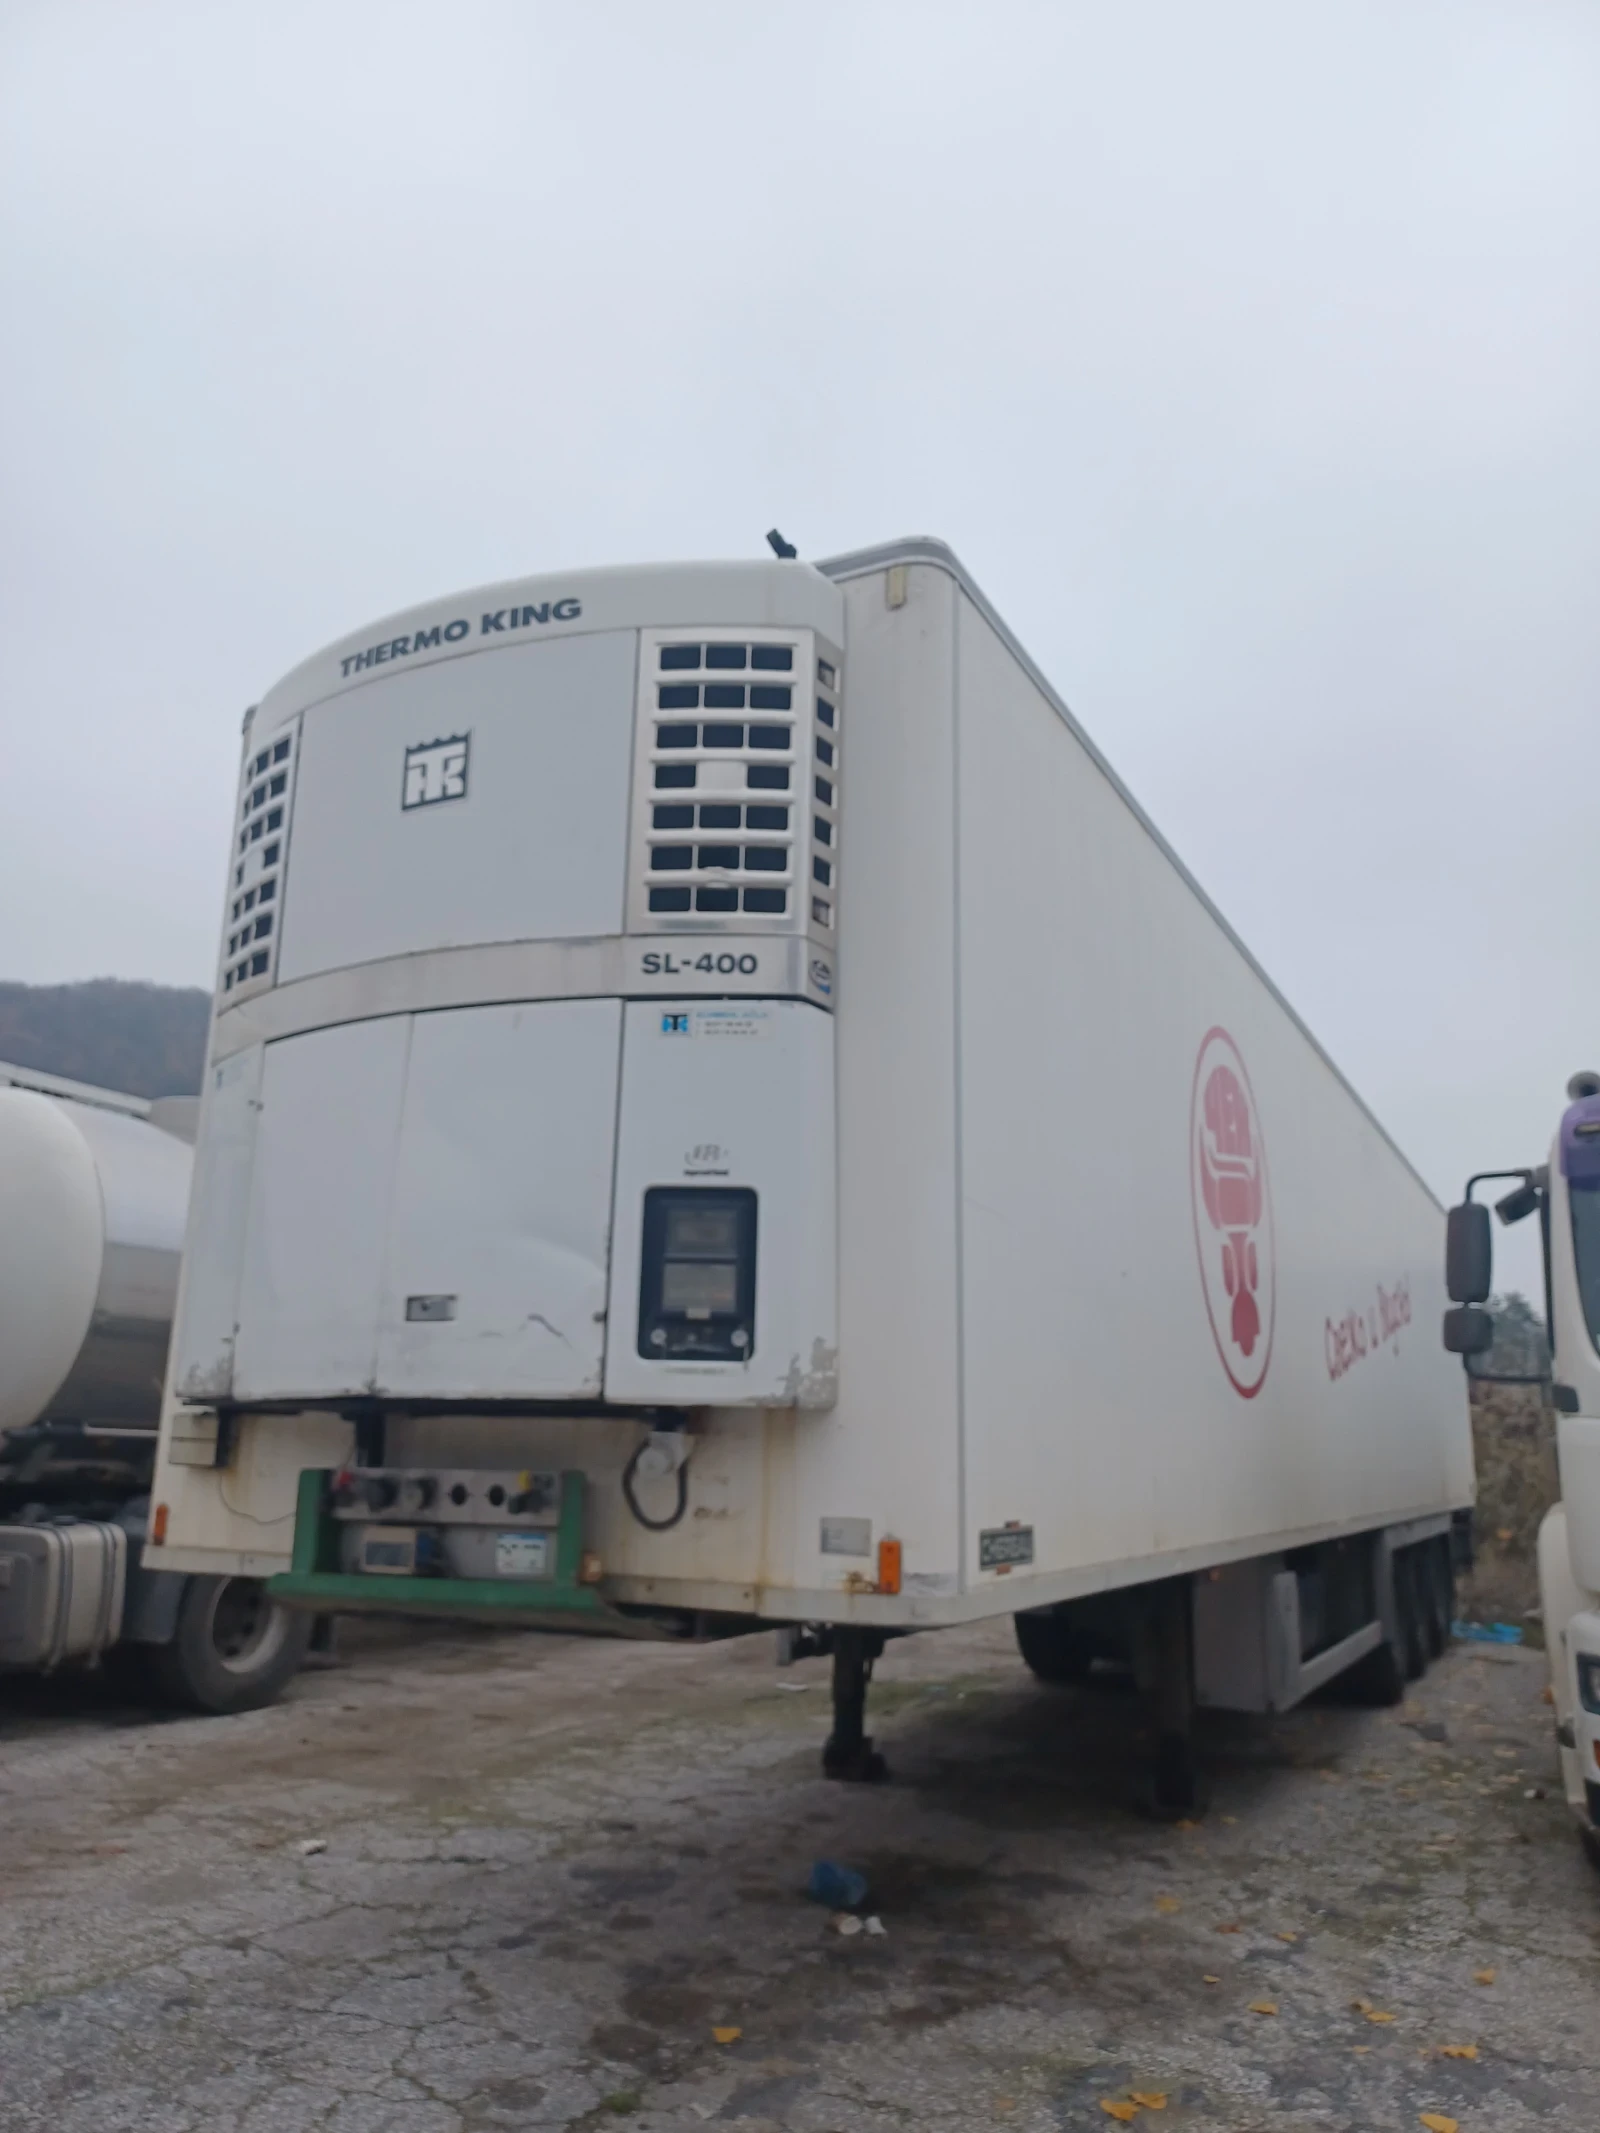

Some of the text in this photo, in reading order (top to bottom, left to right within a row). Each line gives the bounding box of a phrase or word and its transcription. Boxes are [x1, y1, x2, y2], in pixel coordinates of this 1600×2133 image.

[340, 597, 583, 679] THERMO KING
[641, 952, 759, 976] SL-400
